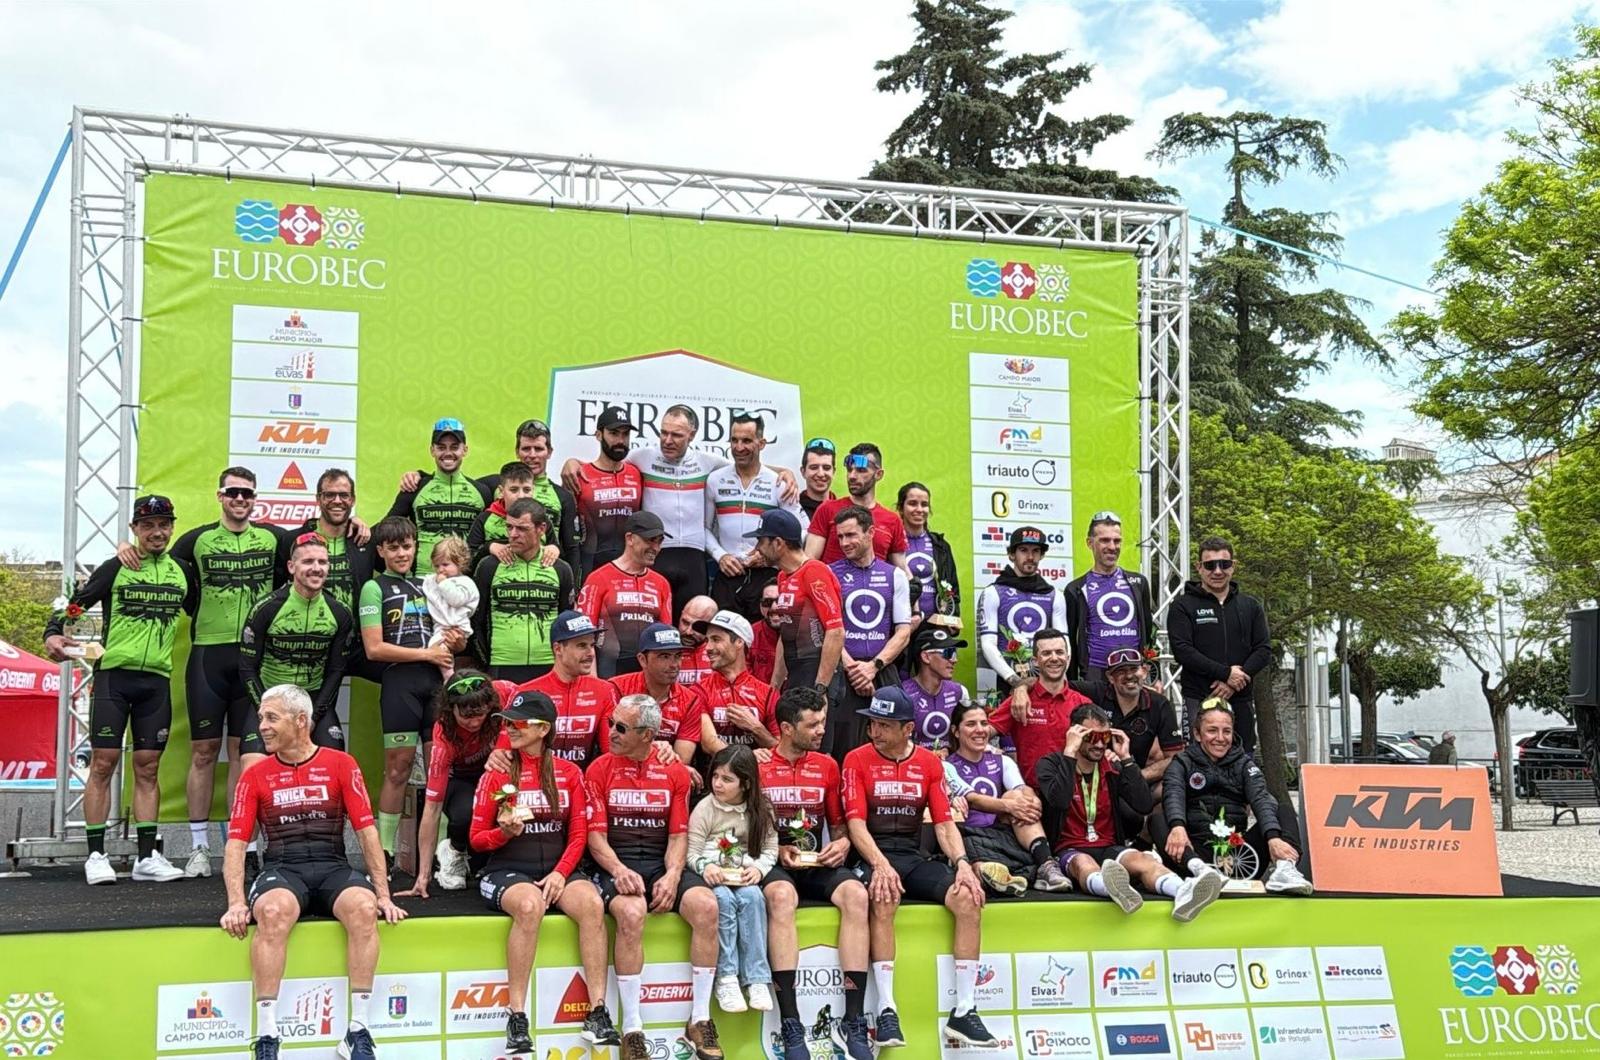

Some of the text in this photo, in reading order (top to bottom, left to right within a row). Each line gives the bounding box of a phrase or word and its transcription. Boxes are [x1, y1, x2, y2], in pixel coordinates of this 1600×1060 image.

[211, 248, 387, 291] EUROBEC
[949, 302, 1089, 339] EUROBEC
[258, 421, 331, 445] KTM
[279, 446, 321, 455] INDUSTRIES
[987, 464, 1030, 477] triauto
[1018, 499, 1049, 511] Brinox
[273, 787, 311, 804] SWICK
[609, 790, 648, 805] SWICK
[876, 806, 917, 816] PRIMUS
[1324, 785, 1475, 831] KTM
[613, 815, 666, 828] PRIMUS
[524, 822, 562, 834] RIMUS
[1332, 836, 1461, 851] BIKE INDUSTRIES
[1275, 968, 1309, 979] Brinox
[1341, 966, 1383, 976] reconco
[1173, 972, 1212, 983] triauto
[1031, 986, 1057, 996] Elvas
[454, 1013, 470, 1021] BIKE
[173, 1020, 229, 1032] MUNICÍPIO
[165, 1030, 245, 1043] CAMPO MAIOR
[1129, 1035, 1160, 1044] BOSCH
